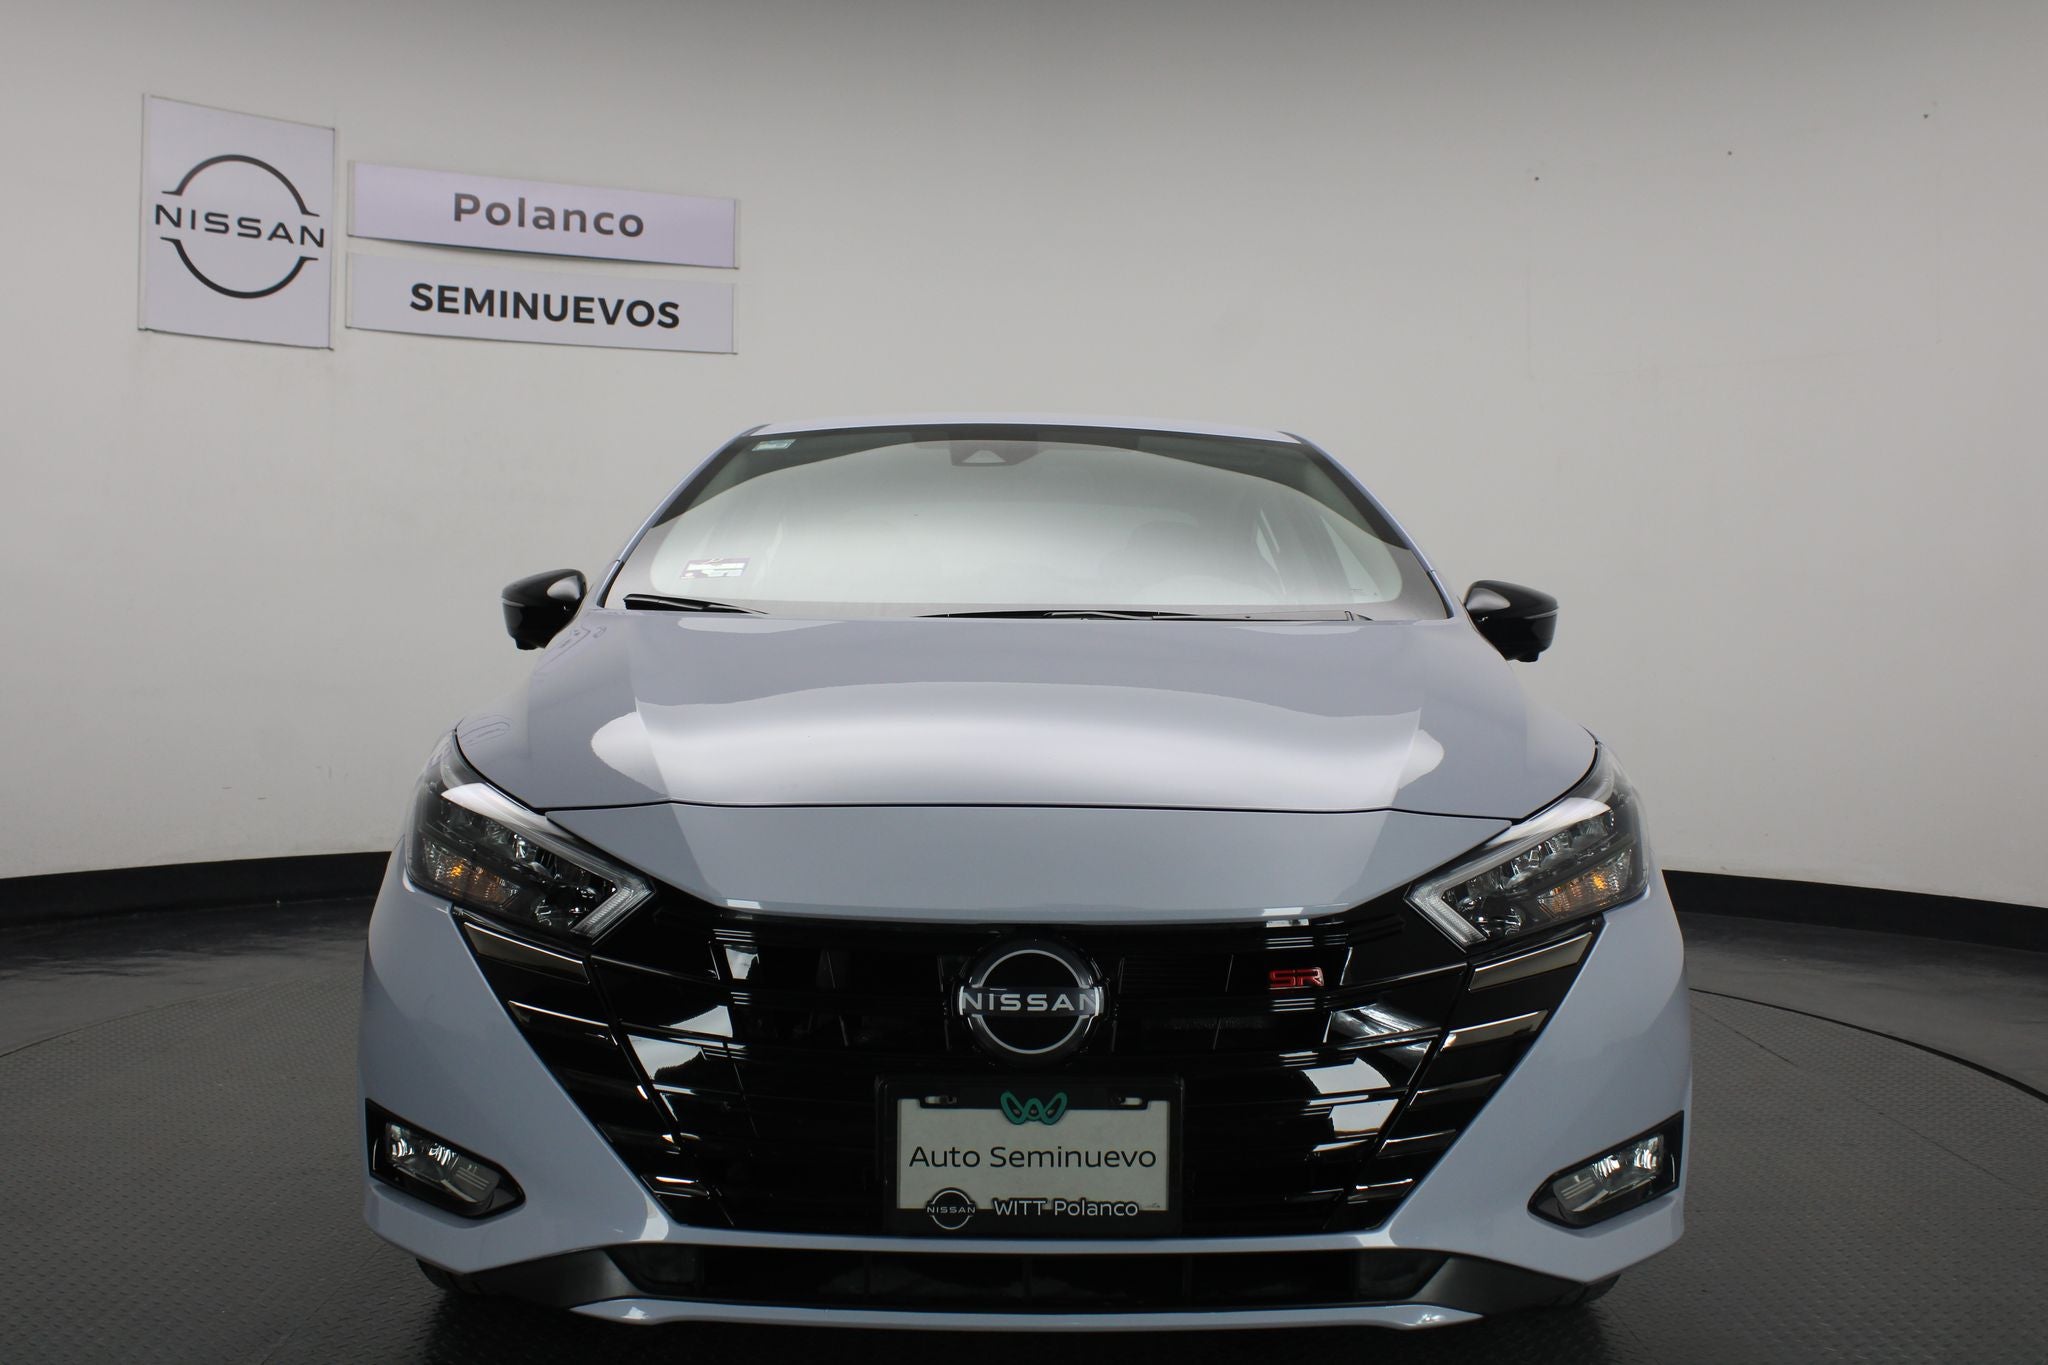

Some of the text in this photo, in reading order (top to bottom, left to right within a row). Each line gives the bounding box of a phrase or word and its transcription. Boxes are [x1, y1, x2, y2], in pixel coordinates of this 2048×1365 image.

[154, 204, 325, 248] NISSAN
[453, 193, 645, 238] Polanco
[410, 282, 680, 329] SEMINUEVOS
[1268, 967, 1325, 988] SR
[960, 993, 1099, 1012] NISSAN
[909, 1146, 1157, 1168] Auto Seminuevo
[926, 1205, 976, 1214] NISSAN
[993, 1199, 1139, 1217] WITT Polanco
